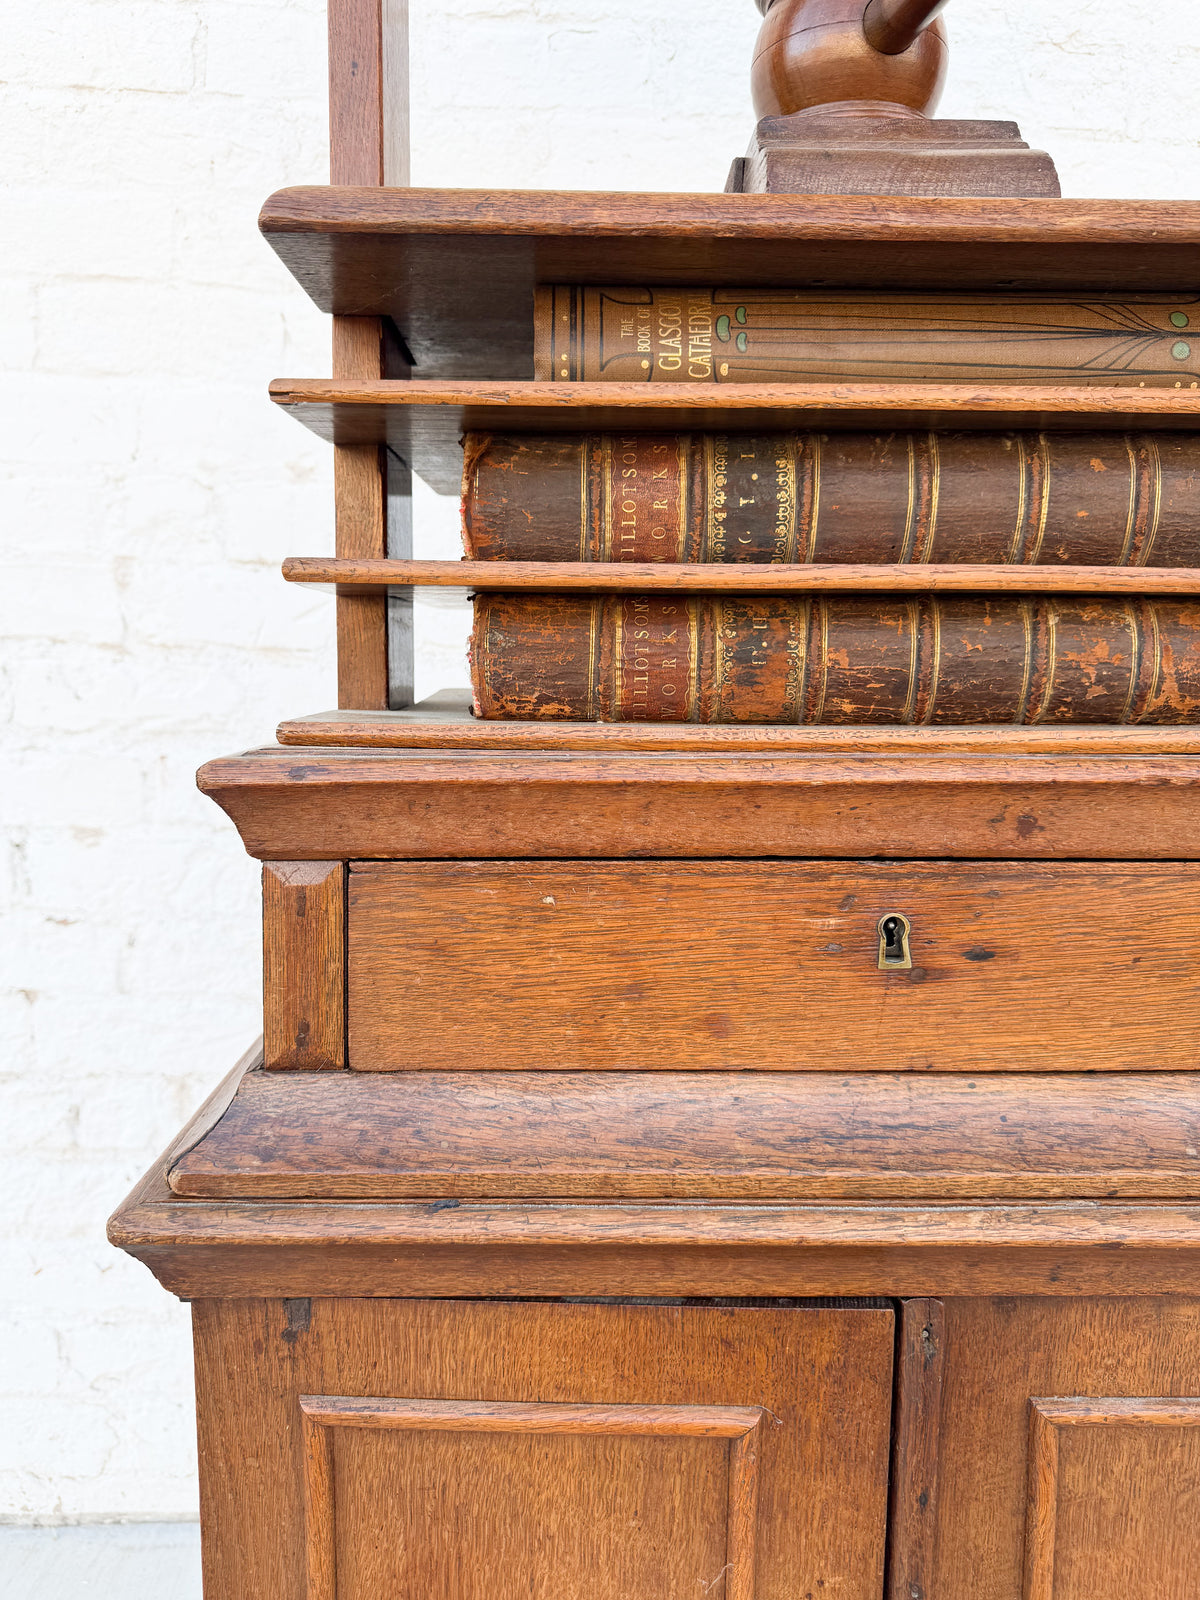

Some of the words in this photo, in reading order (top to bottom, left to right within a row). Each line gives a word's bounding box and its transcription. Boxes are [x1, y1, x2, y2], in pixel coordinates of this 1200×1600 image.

[620, 318, 634, 338] THE
[637, 306, 651, 319] OF
[637, 325, 651, 352] BOOK
[658, 295, 682, 371] GLASGOW
[688, 292, 712, 378] CATHEDRAL
[651, 445, 668, 564] WORKS
[661, 605, 678, 719] WORKS
